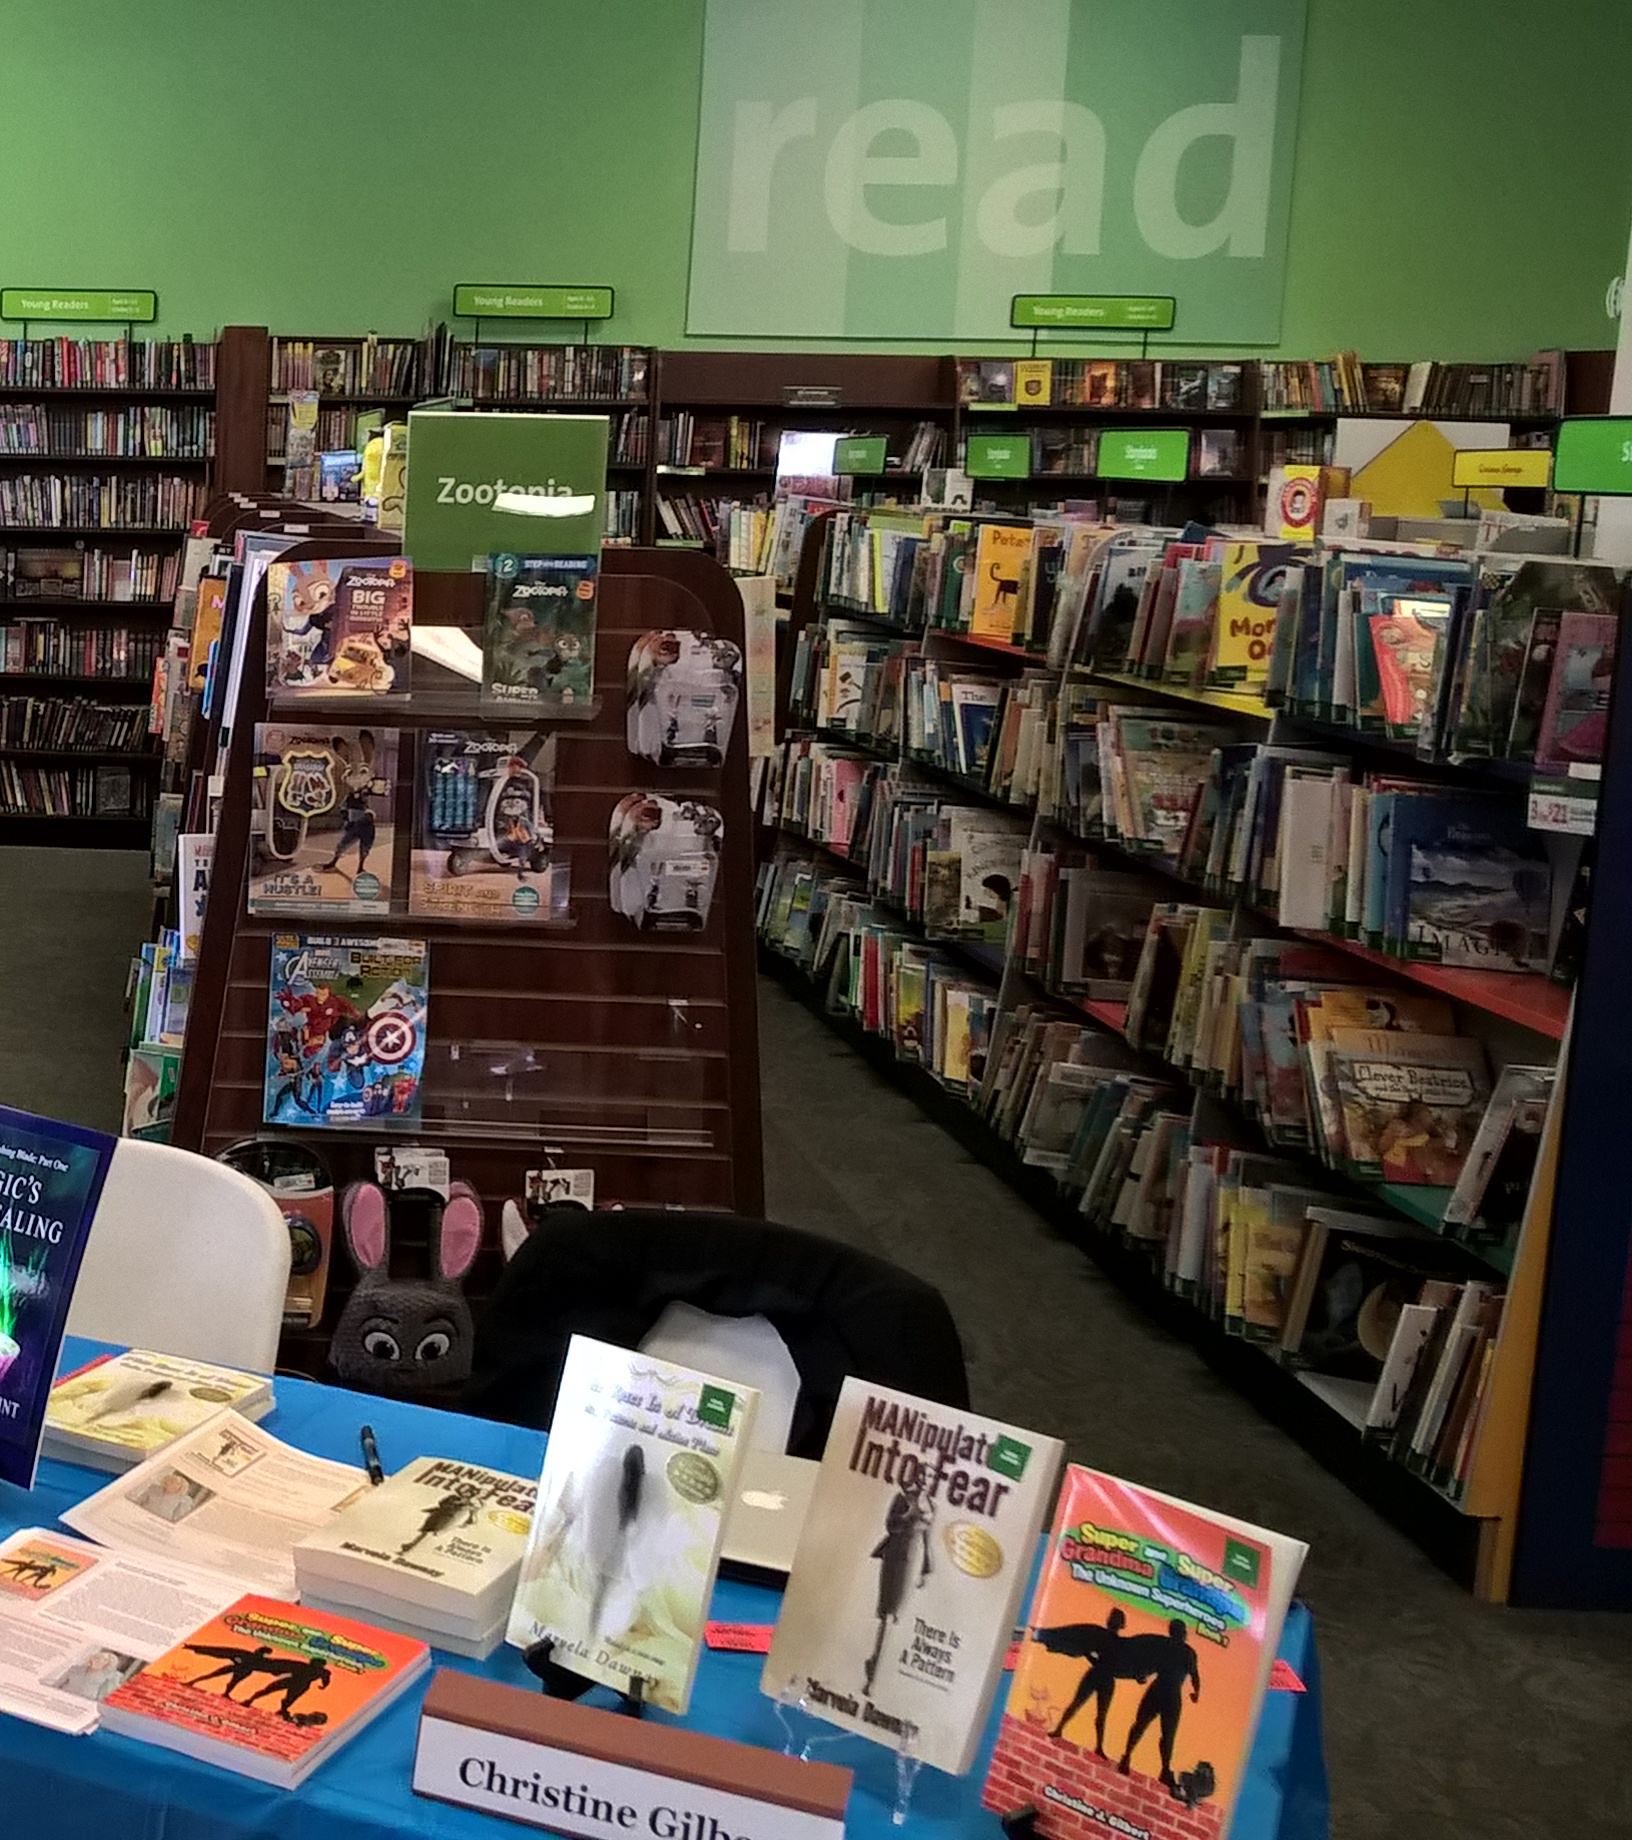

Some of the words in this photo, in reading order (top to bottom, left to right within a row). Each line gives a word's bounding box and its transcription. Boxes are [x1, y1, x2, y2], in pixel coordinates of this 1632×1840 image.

[727, 35, 1281, 259] read
[20, 299, 51, 311] Young
[52, 300, 89, 310] Readers
[474, 296, 504, 308] Young
[1033, 306, 1064, 319] Young
[1065, 307, 1104, 317] Readers
[351, 589, 386, 604] BIG
[37, 1153, 54, 1167] Part
[53, 1158, 70, 1173] One
[856, 1396, 995, 1466] MANipulat
[434, 1461, 538, 1499] MANipulat
[848, 1420, 920, 1488] Into
[928, 1451, 1011, 1518] Fear
[480, 1484, 536, 1516] Fea
[1060, 1537, 1155, 1578] Grandma
[1079, 1520, 1139, 1553] Super
[1177, 1554, 1235, 1592] Super
[1071, 1561, 1095, 1583] The
[1095, 1570, 1151, 1598] Unknown
[1150, 1587, 1226, 1631] Superheroes
[914, 1616, 946, 1646] There
[910, 1636, 954, 1666] Always
[910, 1654, 957, 1684] Pattern
[459, 1755, 638, 1829] Christine
[649, 1806, 752, 1840] Gilb
[1042, 1784, 1096, 1819] Christine
[1107, 1813, 1151, 1840] Gilbert
